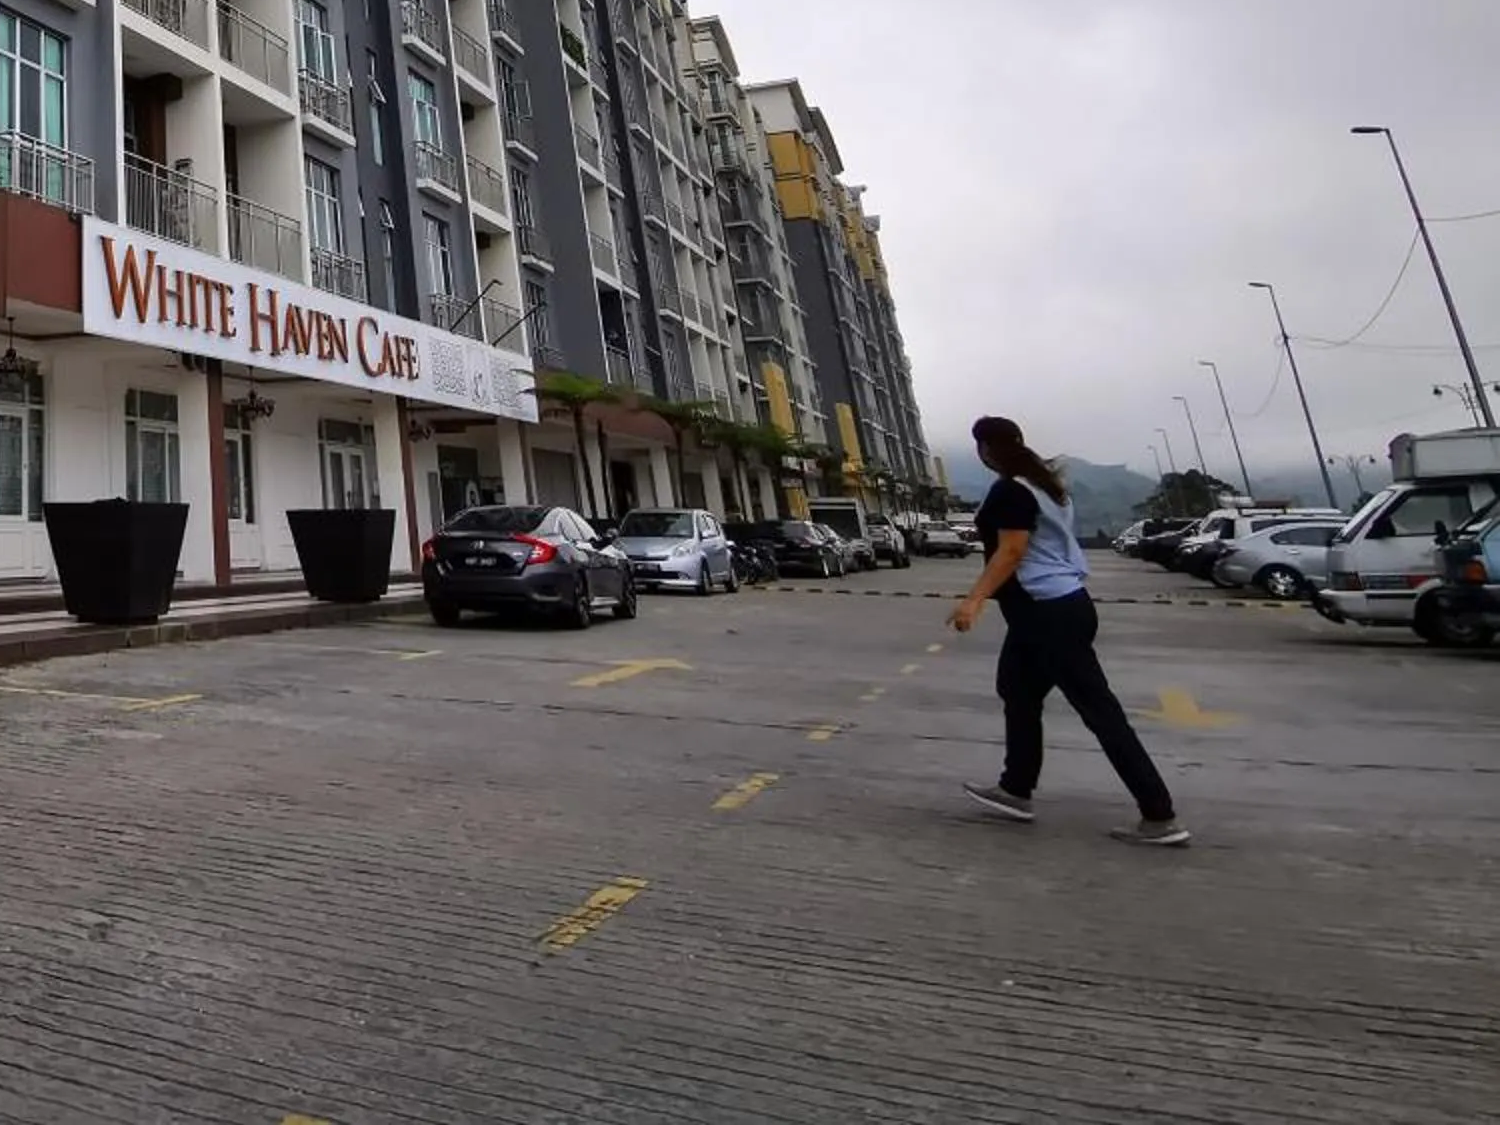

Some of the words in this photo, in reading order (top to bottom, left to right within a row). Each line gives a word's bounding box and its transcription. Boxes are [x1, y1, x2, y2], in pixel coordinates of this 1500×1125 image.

[99, 234, 238, 339] WHITE
[246, 282, 350, 364] HAVEN
[357, 316, 420, 381] CAFE
